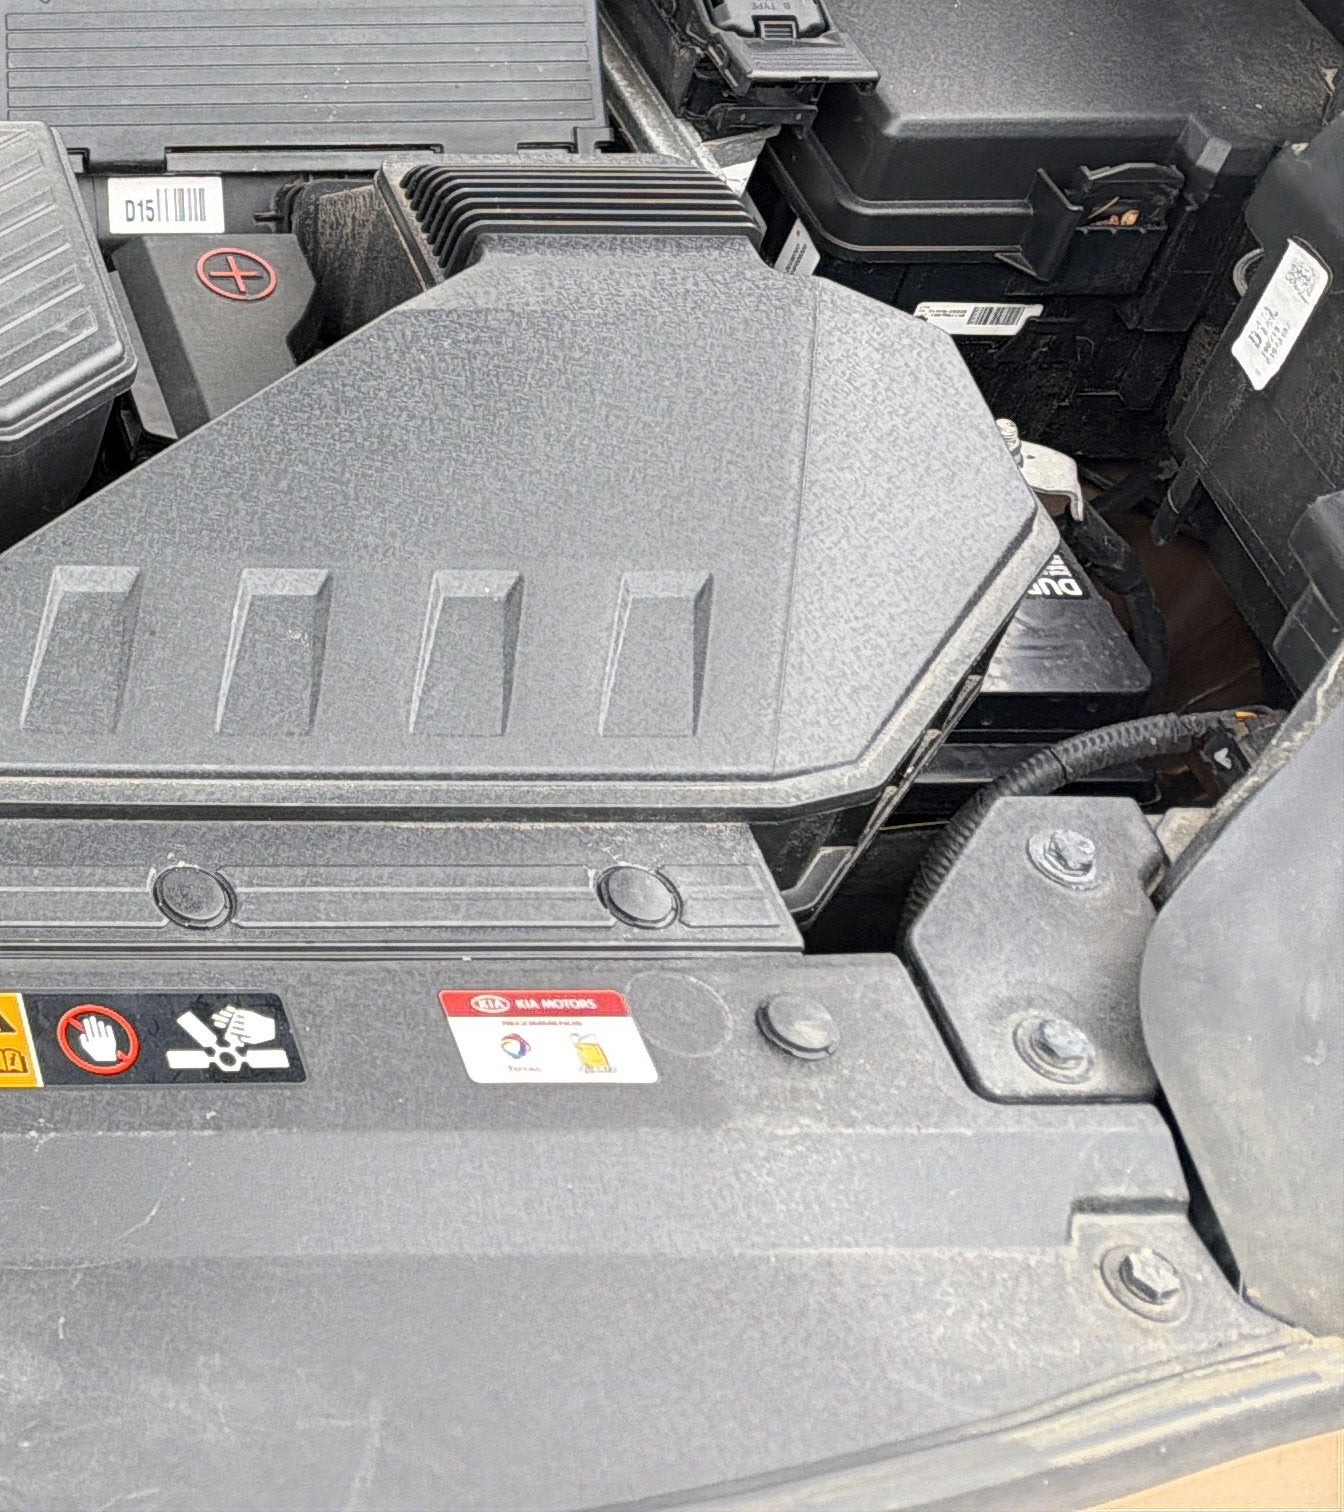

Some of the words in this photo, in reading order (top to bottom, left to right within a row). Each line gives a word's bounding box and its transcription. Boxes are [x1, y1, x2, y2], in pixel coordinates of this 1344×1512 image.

[125, 199, 155, 222] D15
[515, 999, 540, 1009] KIA
[541, 998, 598, 1010] MOTORS
